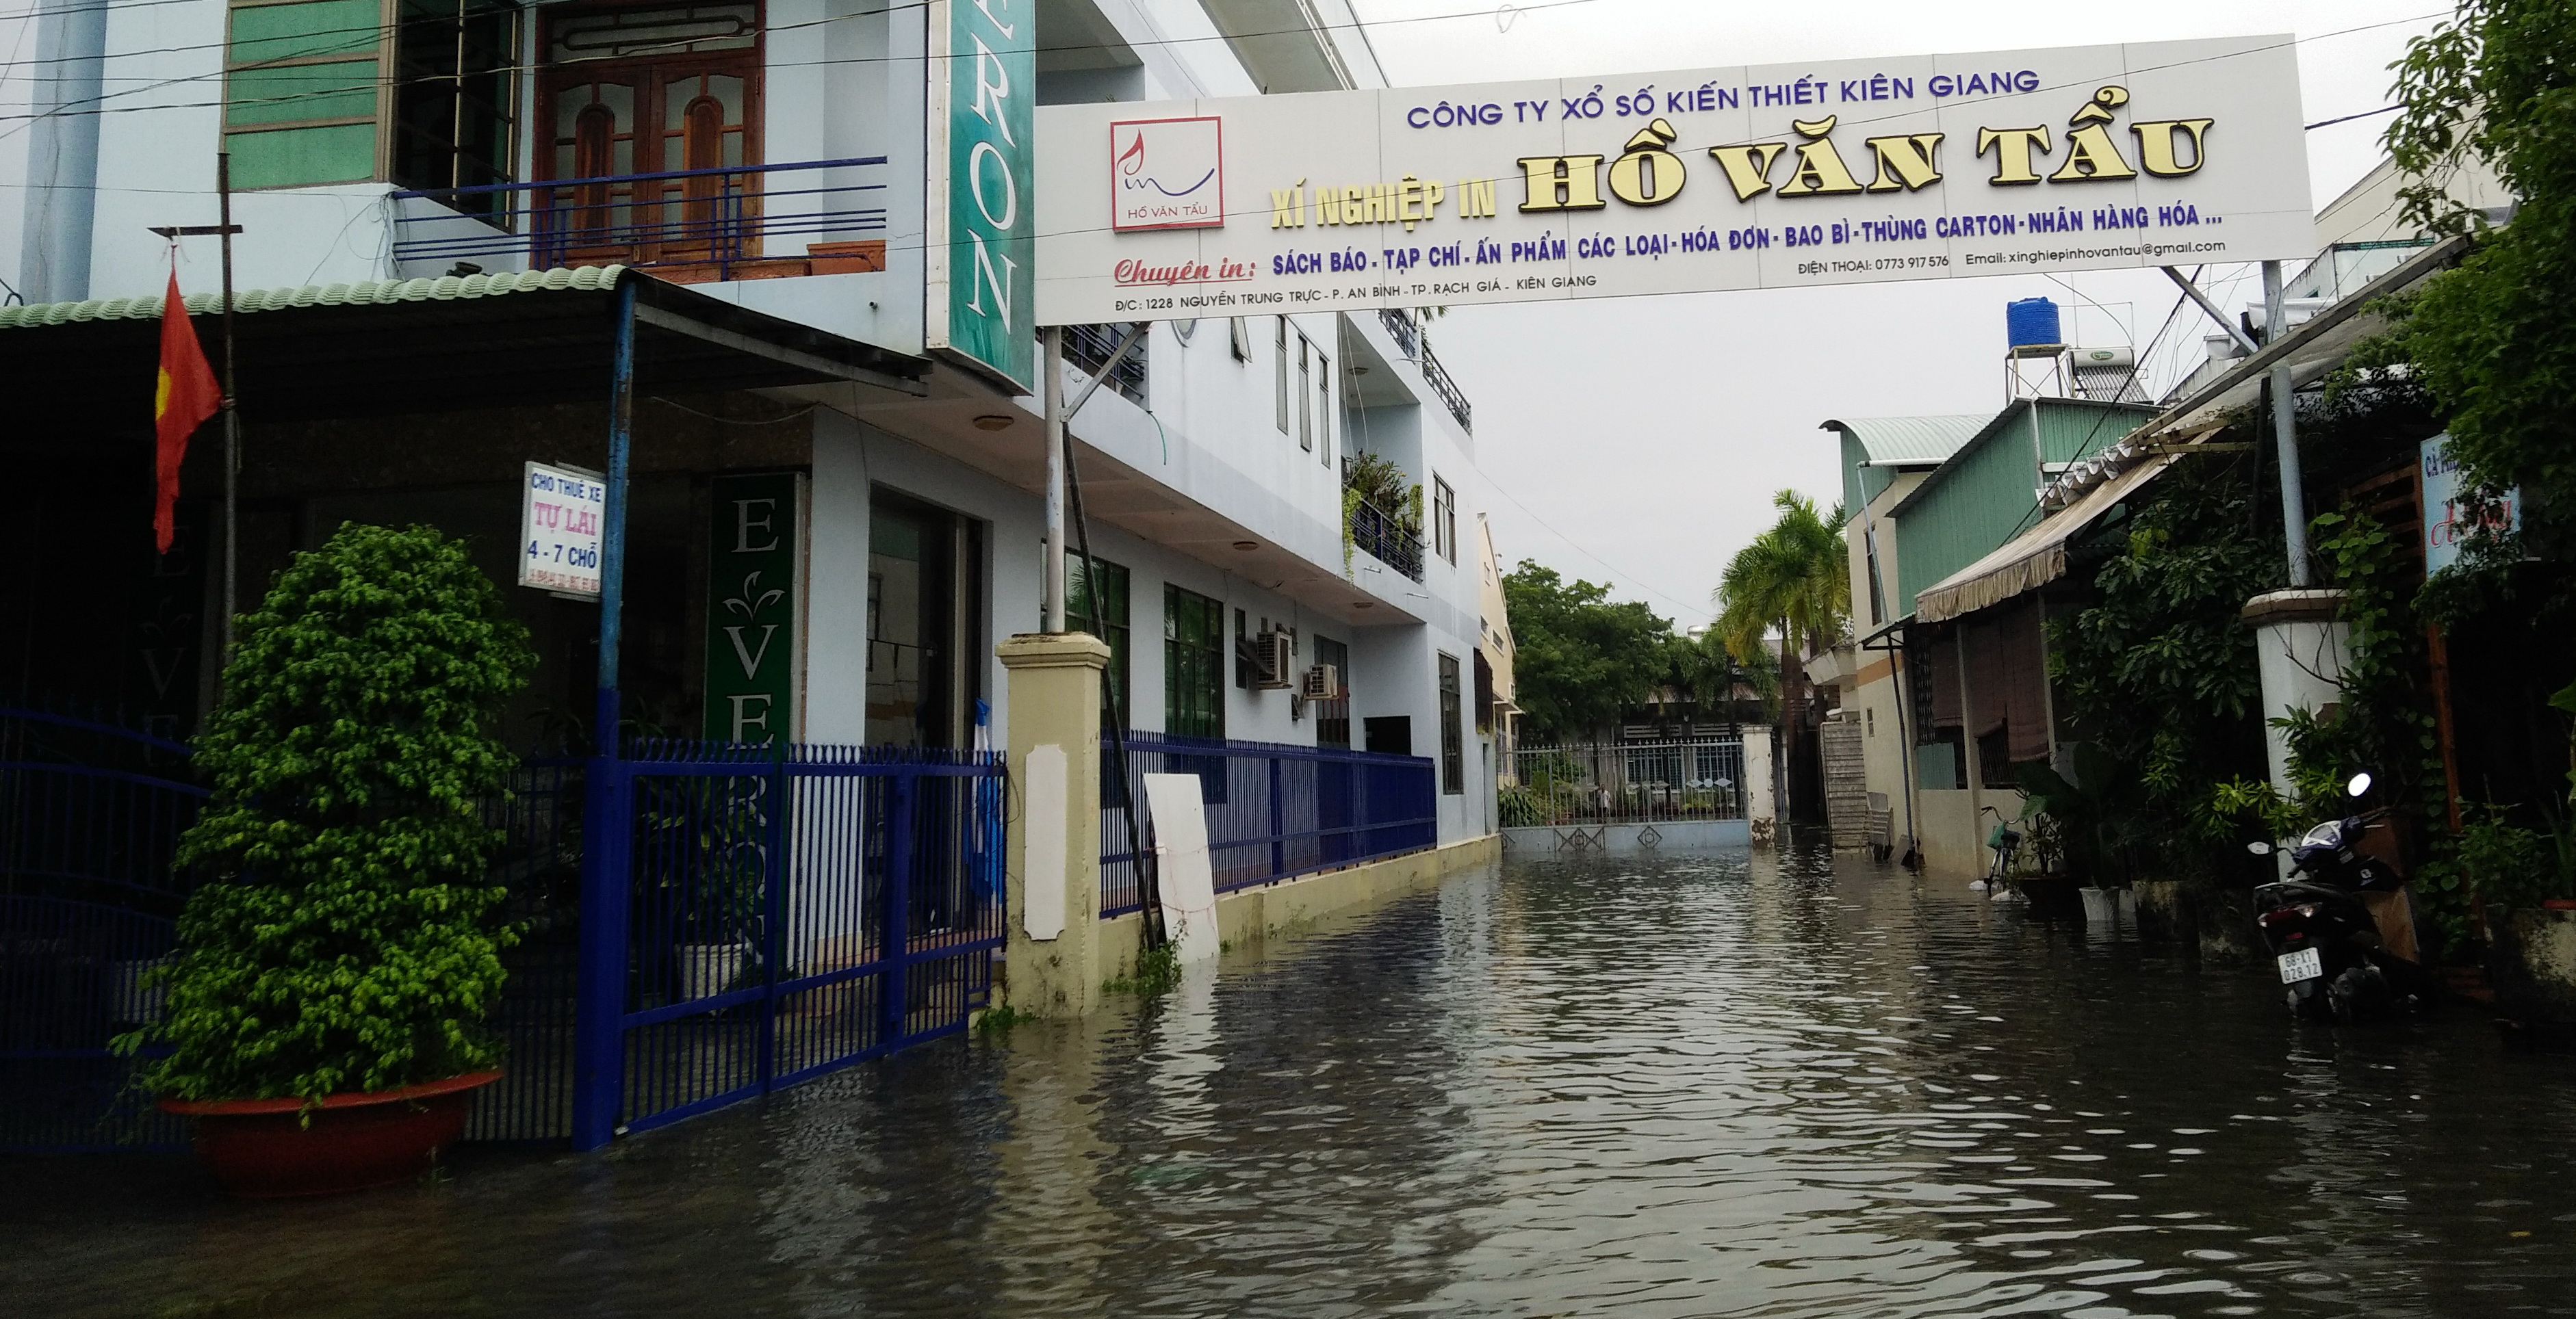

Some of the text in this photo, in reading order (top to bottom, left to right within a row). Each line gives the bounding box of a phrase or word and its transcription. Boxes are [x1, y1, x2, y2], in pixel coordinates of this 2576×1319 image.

[1407, 70, 2039, 129] CÔNG TY XỔ SỐ KIẾN THIẾT KIÊN GIANG
[1517, 85, 2215, 213] HỒ VĂN TẨU
[1151, 206, 1178, 218] VĂN
[1183, 202, 1208, 216] TẨU
[1270, 174, 1497, 232] XÍ NGHIỆP IN
[1273, 249, 1322, 275] SÁCH
[1330, 246, 1367, 272] BÁO
[1383, 248, 1420, 274] TẠP
[1428, 240, 1462, 267] CHÍ
[1476, 237, 1501, 264] ẤN
[1511, 230, 1567, 262] PHẨM
[1577, 232, 1615, 258] CÁC
[1785, 224, 1823, 247] BAO
[2093, 204, 2149, 231] HÀNG
[2158, 200, 2200, 226] HÓA
[1114, 257, 1256, 286] Chuyên in:
[1799, 261, 1828, 276] ĐIỆN
[1831, 259, 1872, 273] THOẠI:
[1875, 258, 1905, 270] 0773
[1966, 253, 2006, 265] Email:
[1146, 298, 1173, 309] 1228
[1181, 290, 1236, 308] NGUYỄN
[1241, 292, 1284, 305] TRUNG
[1289, 289, 1322, 304] TRỰC
[1348, 287, 1367, 299] AN
[1373, 283, 1400, 298] BÌNH
[1477, 278, 1502, 292] GIÁ
[1517, 276, 1545, 290] KIÊN
[1552, 275, 1597, 288] GIANG
[532, 472, 602, 503] CHO THUÊ XE
[534, 501, 597, 536] TỰ LÁI
[528, 540, 538, 559] 4
[554, 544, 563, 563] 7
[568, 542, 597, 569] CHỖ
